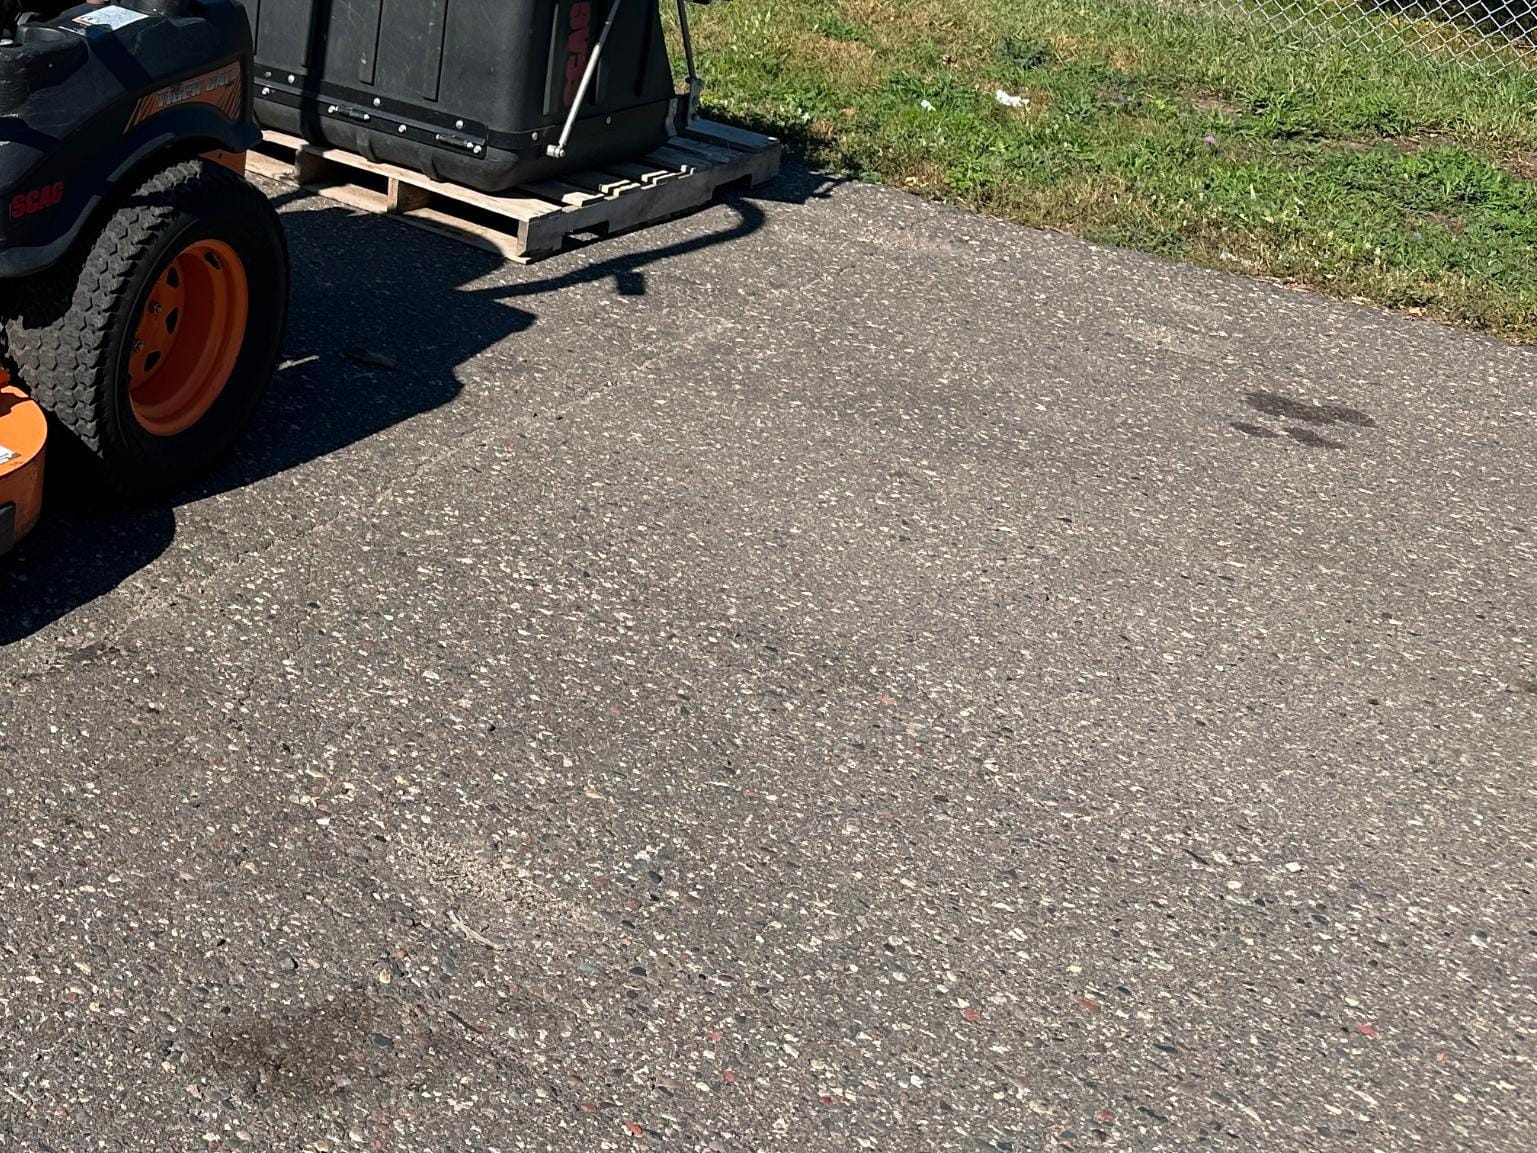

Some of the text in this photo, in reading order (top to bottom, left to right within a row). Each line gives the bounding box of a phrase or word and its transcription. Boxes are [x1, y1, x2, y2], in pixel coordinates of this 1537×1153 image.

[157, 67, 233, 108] TIGER CAT
[11, 179, 65, 218] SCAG
